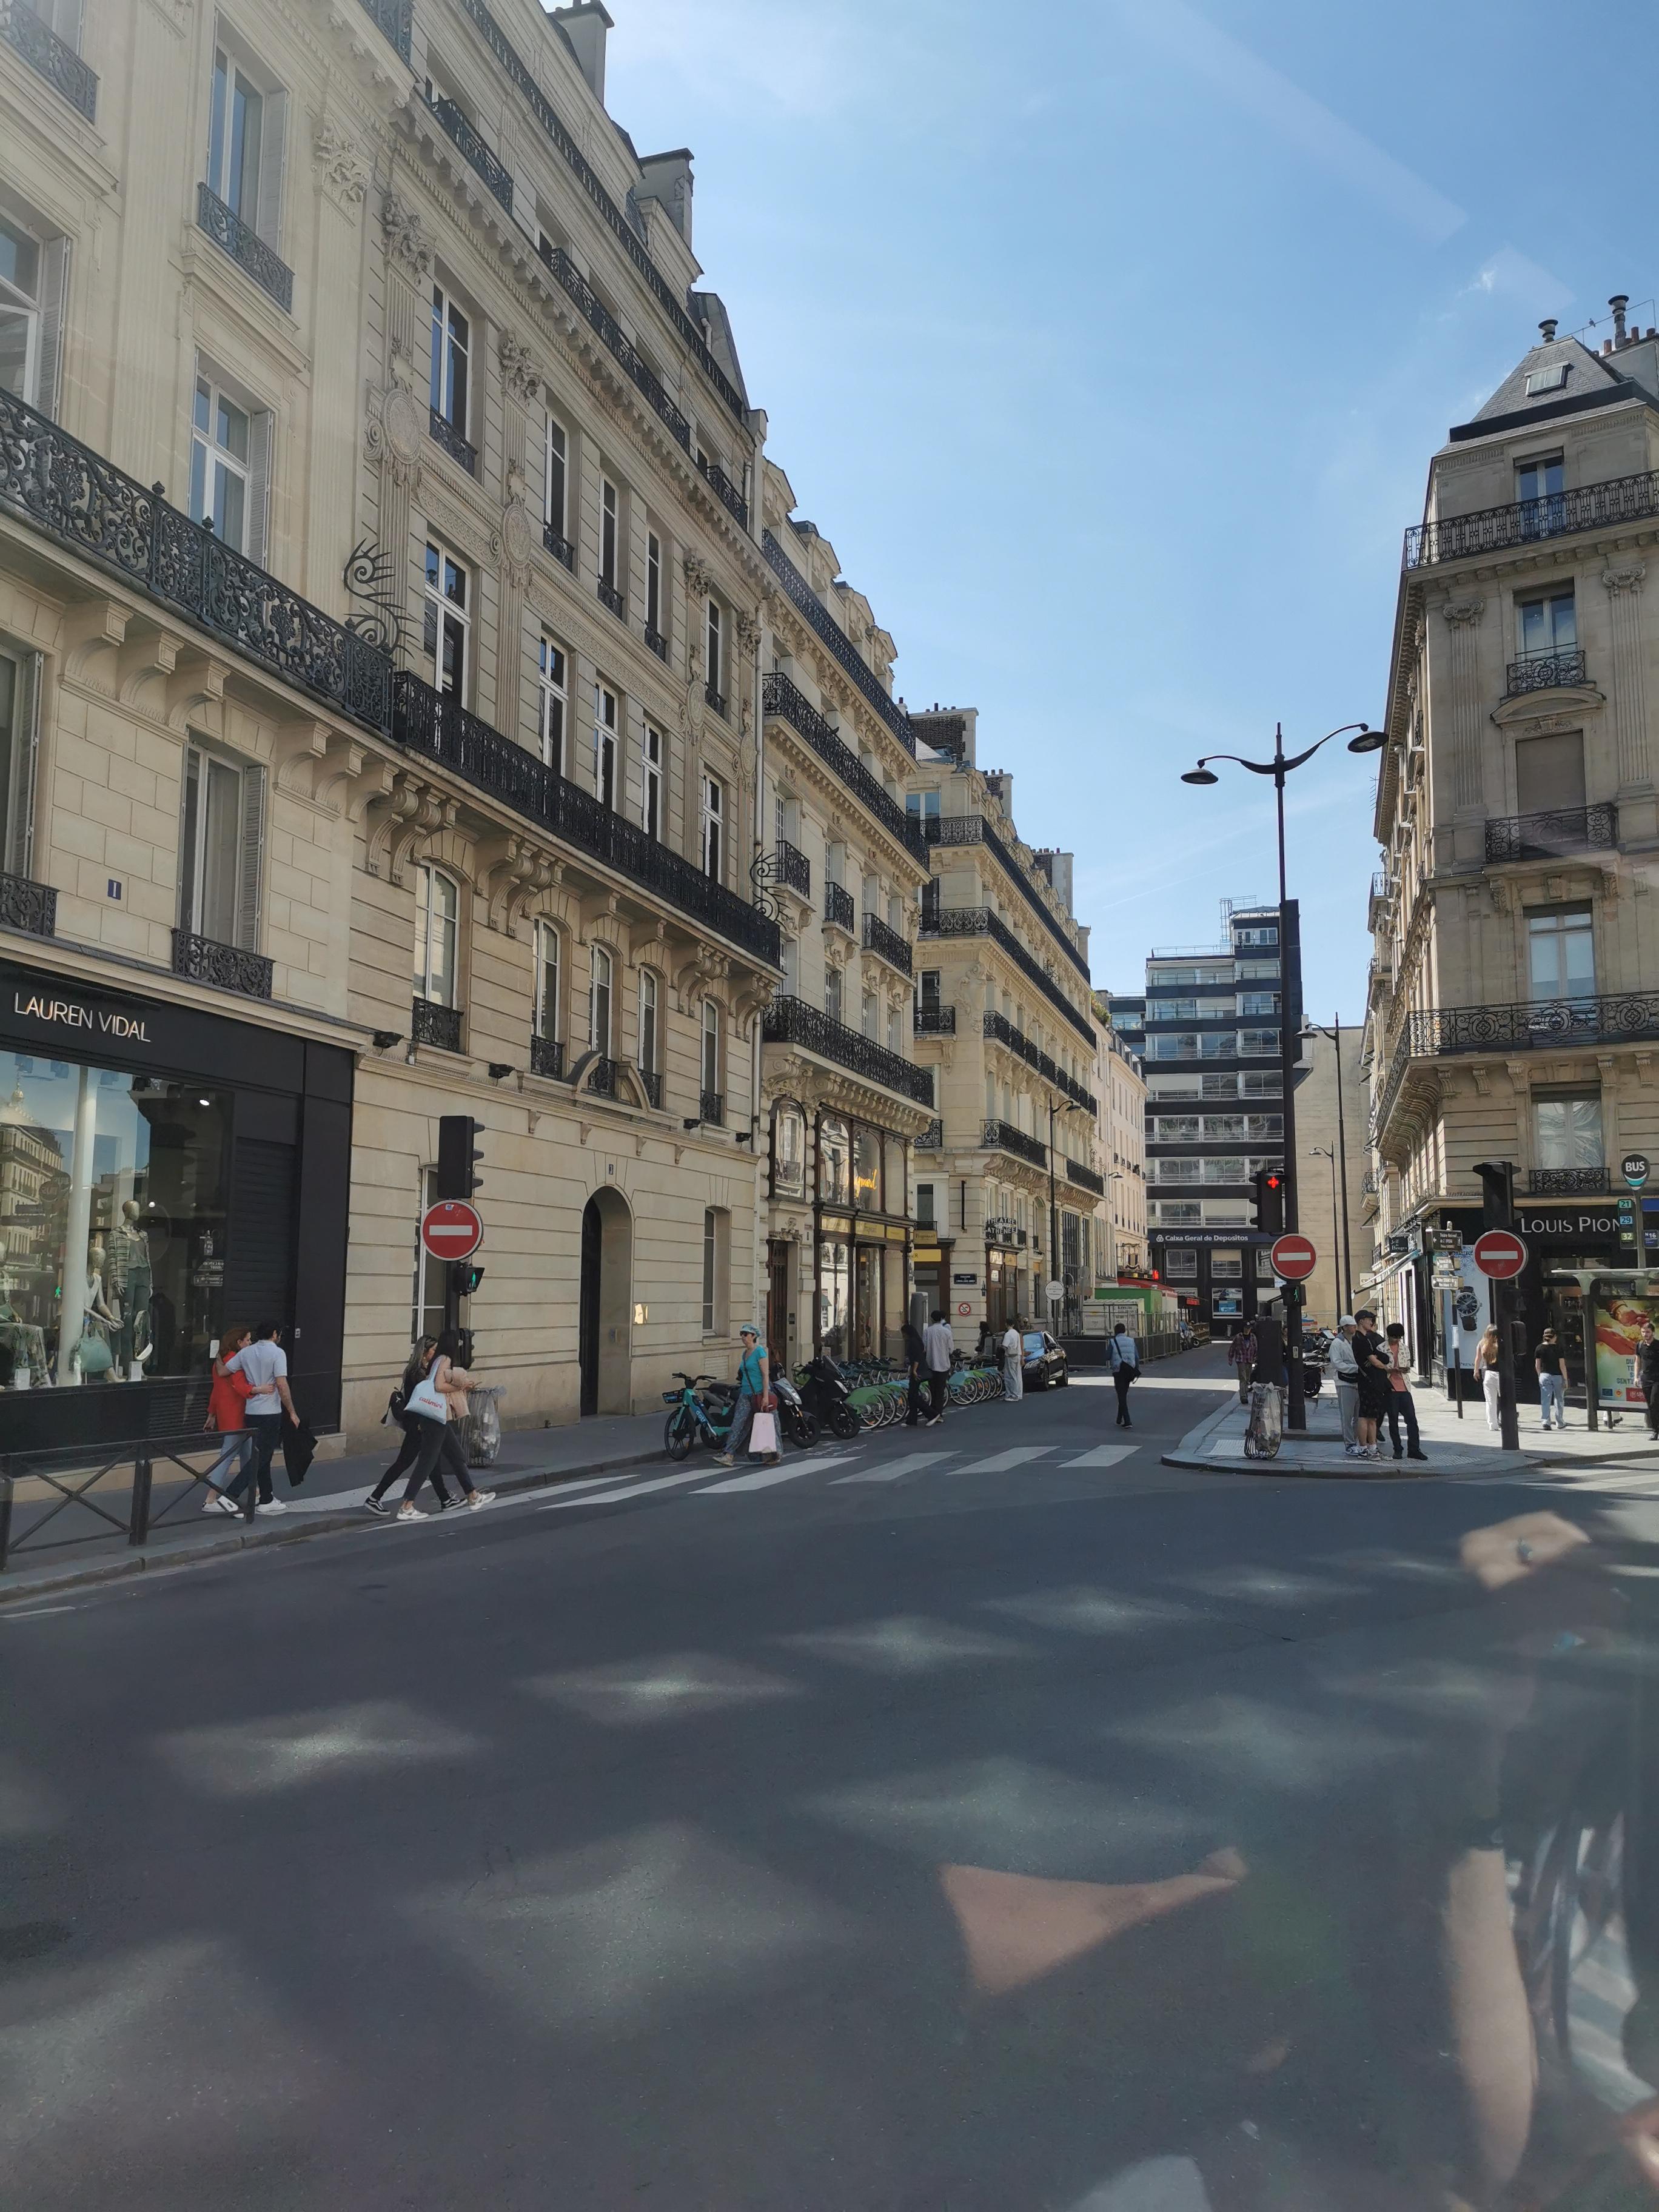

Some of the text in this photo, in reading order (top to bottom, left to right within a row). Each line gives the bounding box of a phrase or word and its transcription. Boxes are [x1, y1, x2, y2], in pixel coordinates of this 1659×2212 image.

[14, 991, 151, 1042] LAUREN VIDAL
[1625, 1161, 1645, 1172] BUS
[1521, 1217, 1573, 1233] LOUIS
